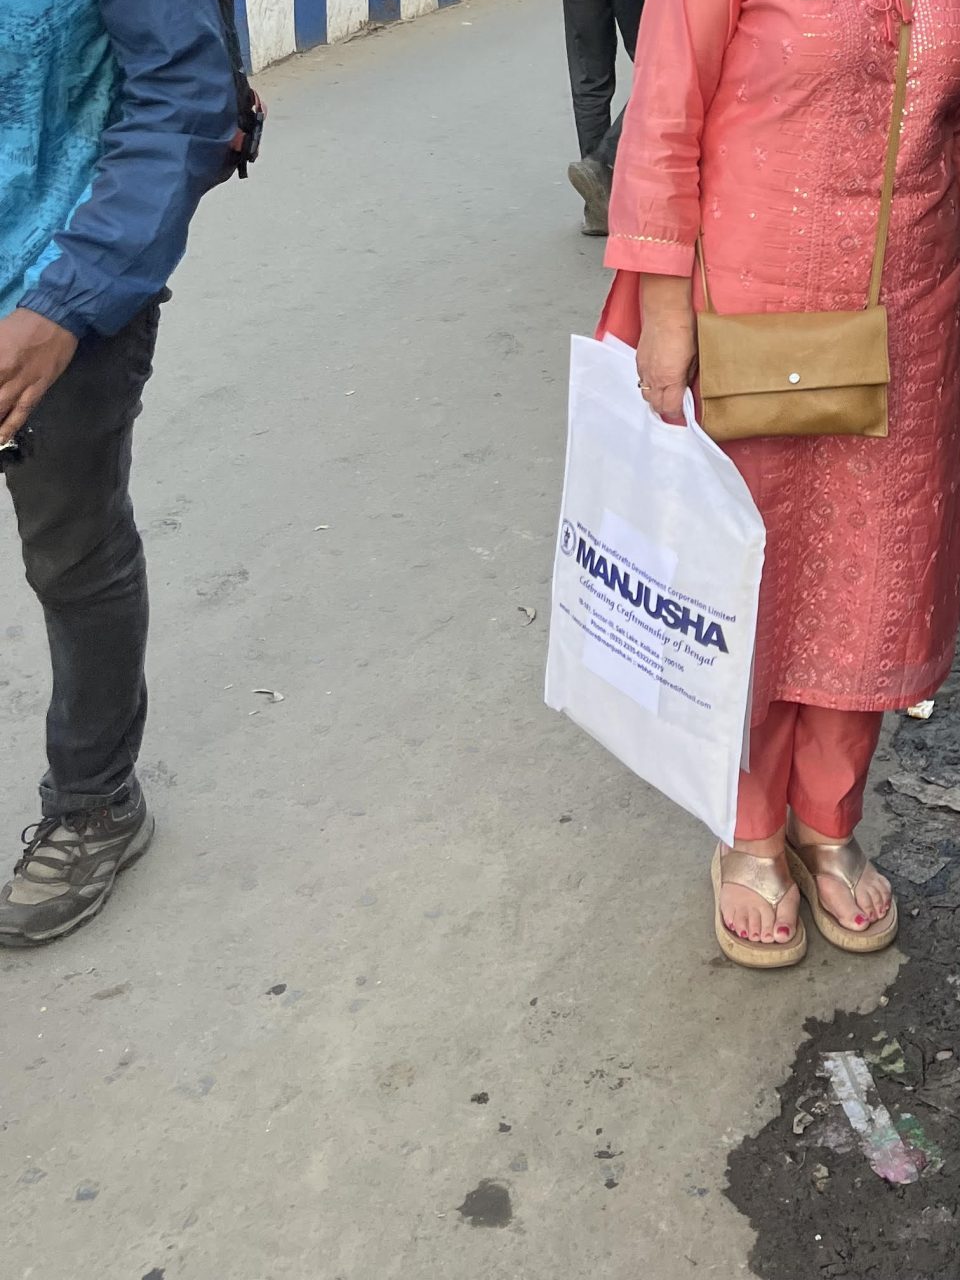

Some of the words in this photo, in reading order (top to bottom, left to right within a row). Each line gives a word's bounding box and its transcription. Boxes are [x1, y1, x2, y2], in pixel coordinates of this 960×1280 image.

[576, 536, 730, 655] MANJUSHA
[579, 575, 616, 612] Celebrating
[616, 602, 671, 646] Craftsmanship
[673, 639, 685, 653] of
[684, 644, 718, 667] Bengal
[631, 563, 666, 591] Development
[667, 586, 707, 611] Corporation
[708, 606, 736, 623] Limited
